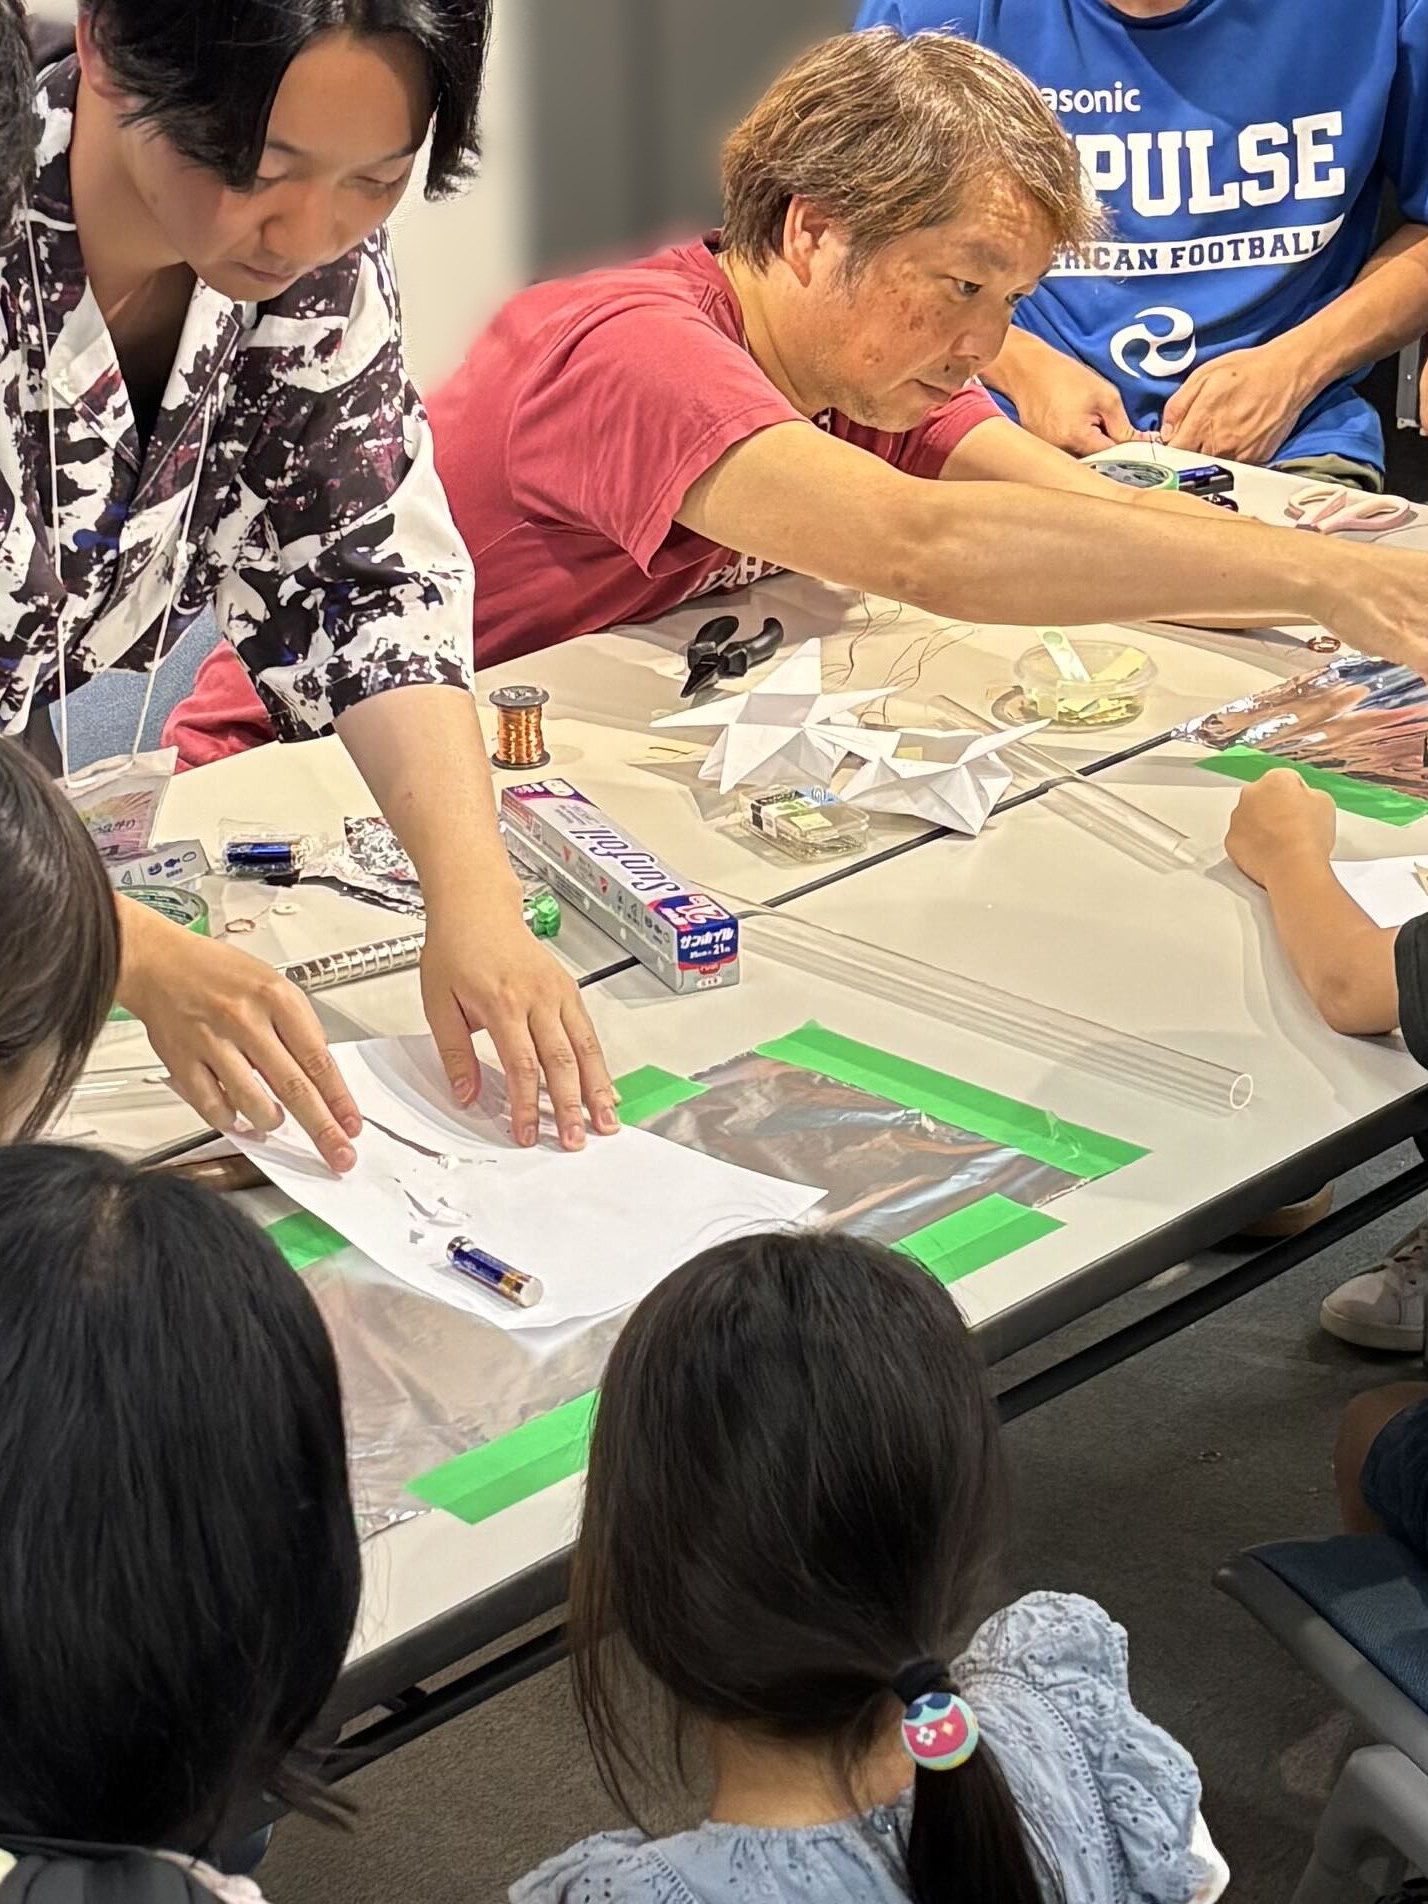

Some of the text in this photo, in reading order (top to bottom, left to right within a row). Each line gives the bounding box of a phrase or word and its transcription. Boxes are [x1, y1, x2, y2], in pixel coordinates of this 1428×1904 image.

[1041, 80, 1142, 114] asonic
[1066, 110, 1346, 218] PULSE
[1051, 230, 1324, 271] ERICAN FOOTBALL
[567, 828, 682, 892] Sunfoil
